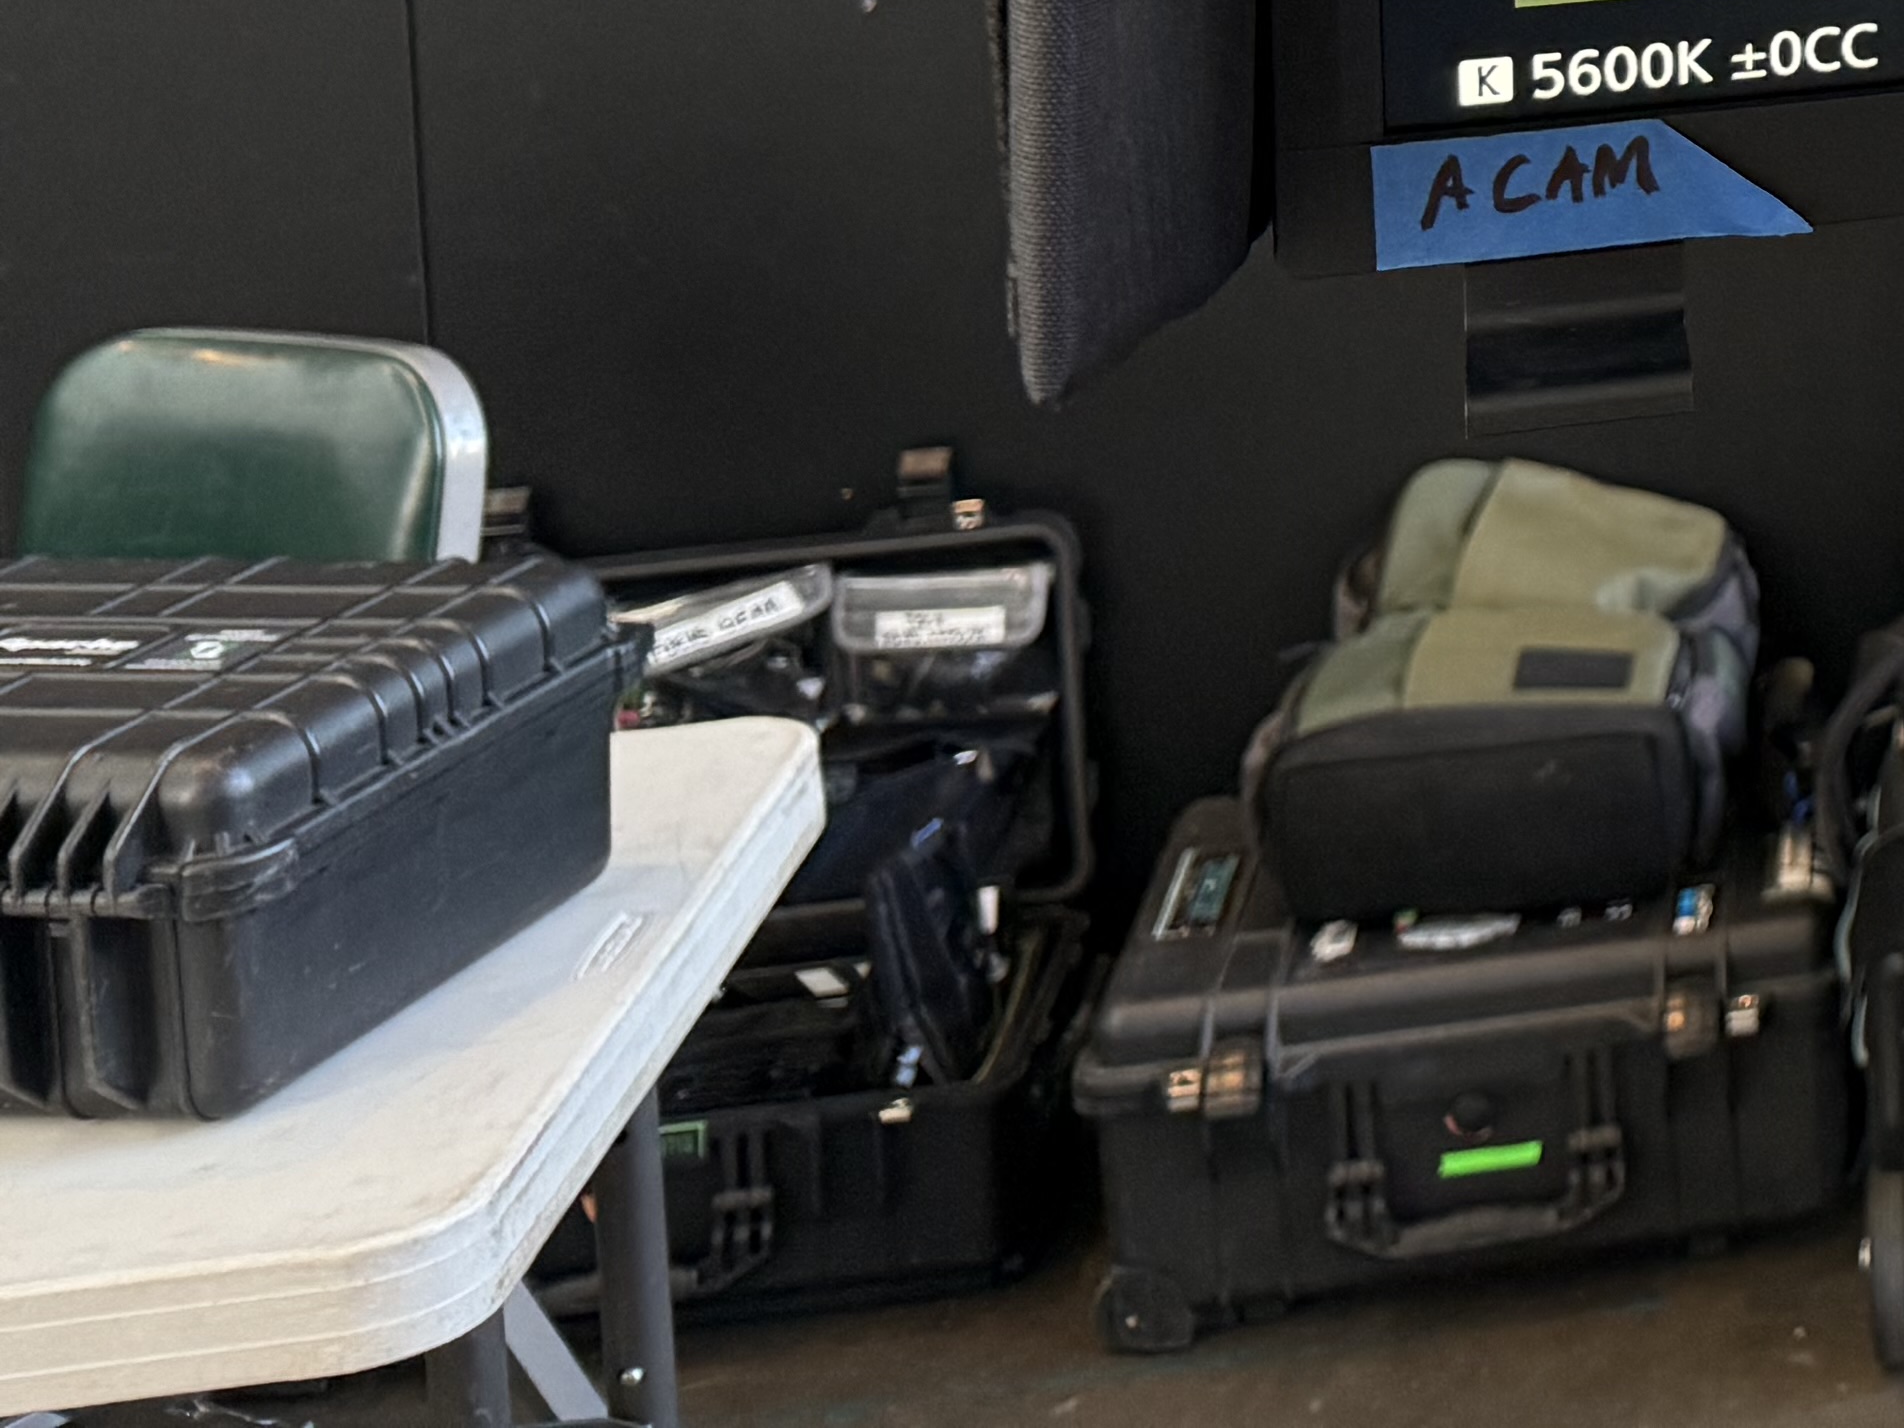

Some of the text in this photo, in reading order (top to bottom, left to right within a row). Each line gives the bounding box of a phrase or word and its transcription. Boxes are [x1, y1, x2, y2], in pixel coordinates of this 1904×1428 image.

[1531, 37, 1714, 100] 5600K
[1729, 22, 1879, 81] ±0CC
[1420, 135, 1661, 232] A CAM
